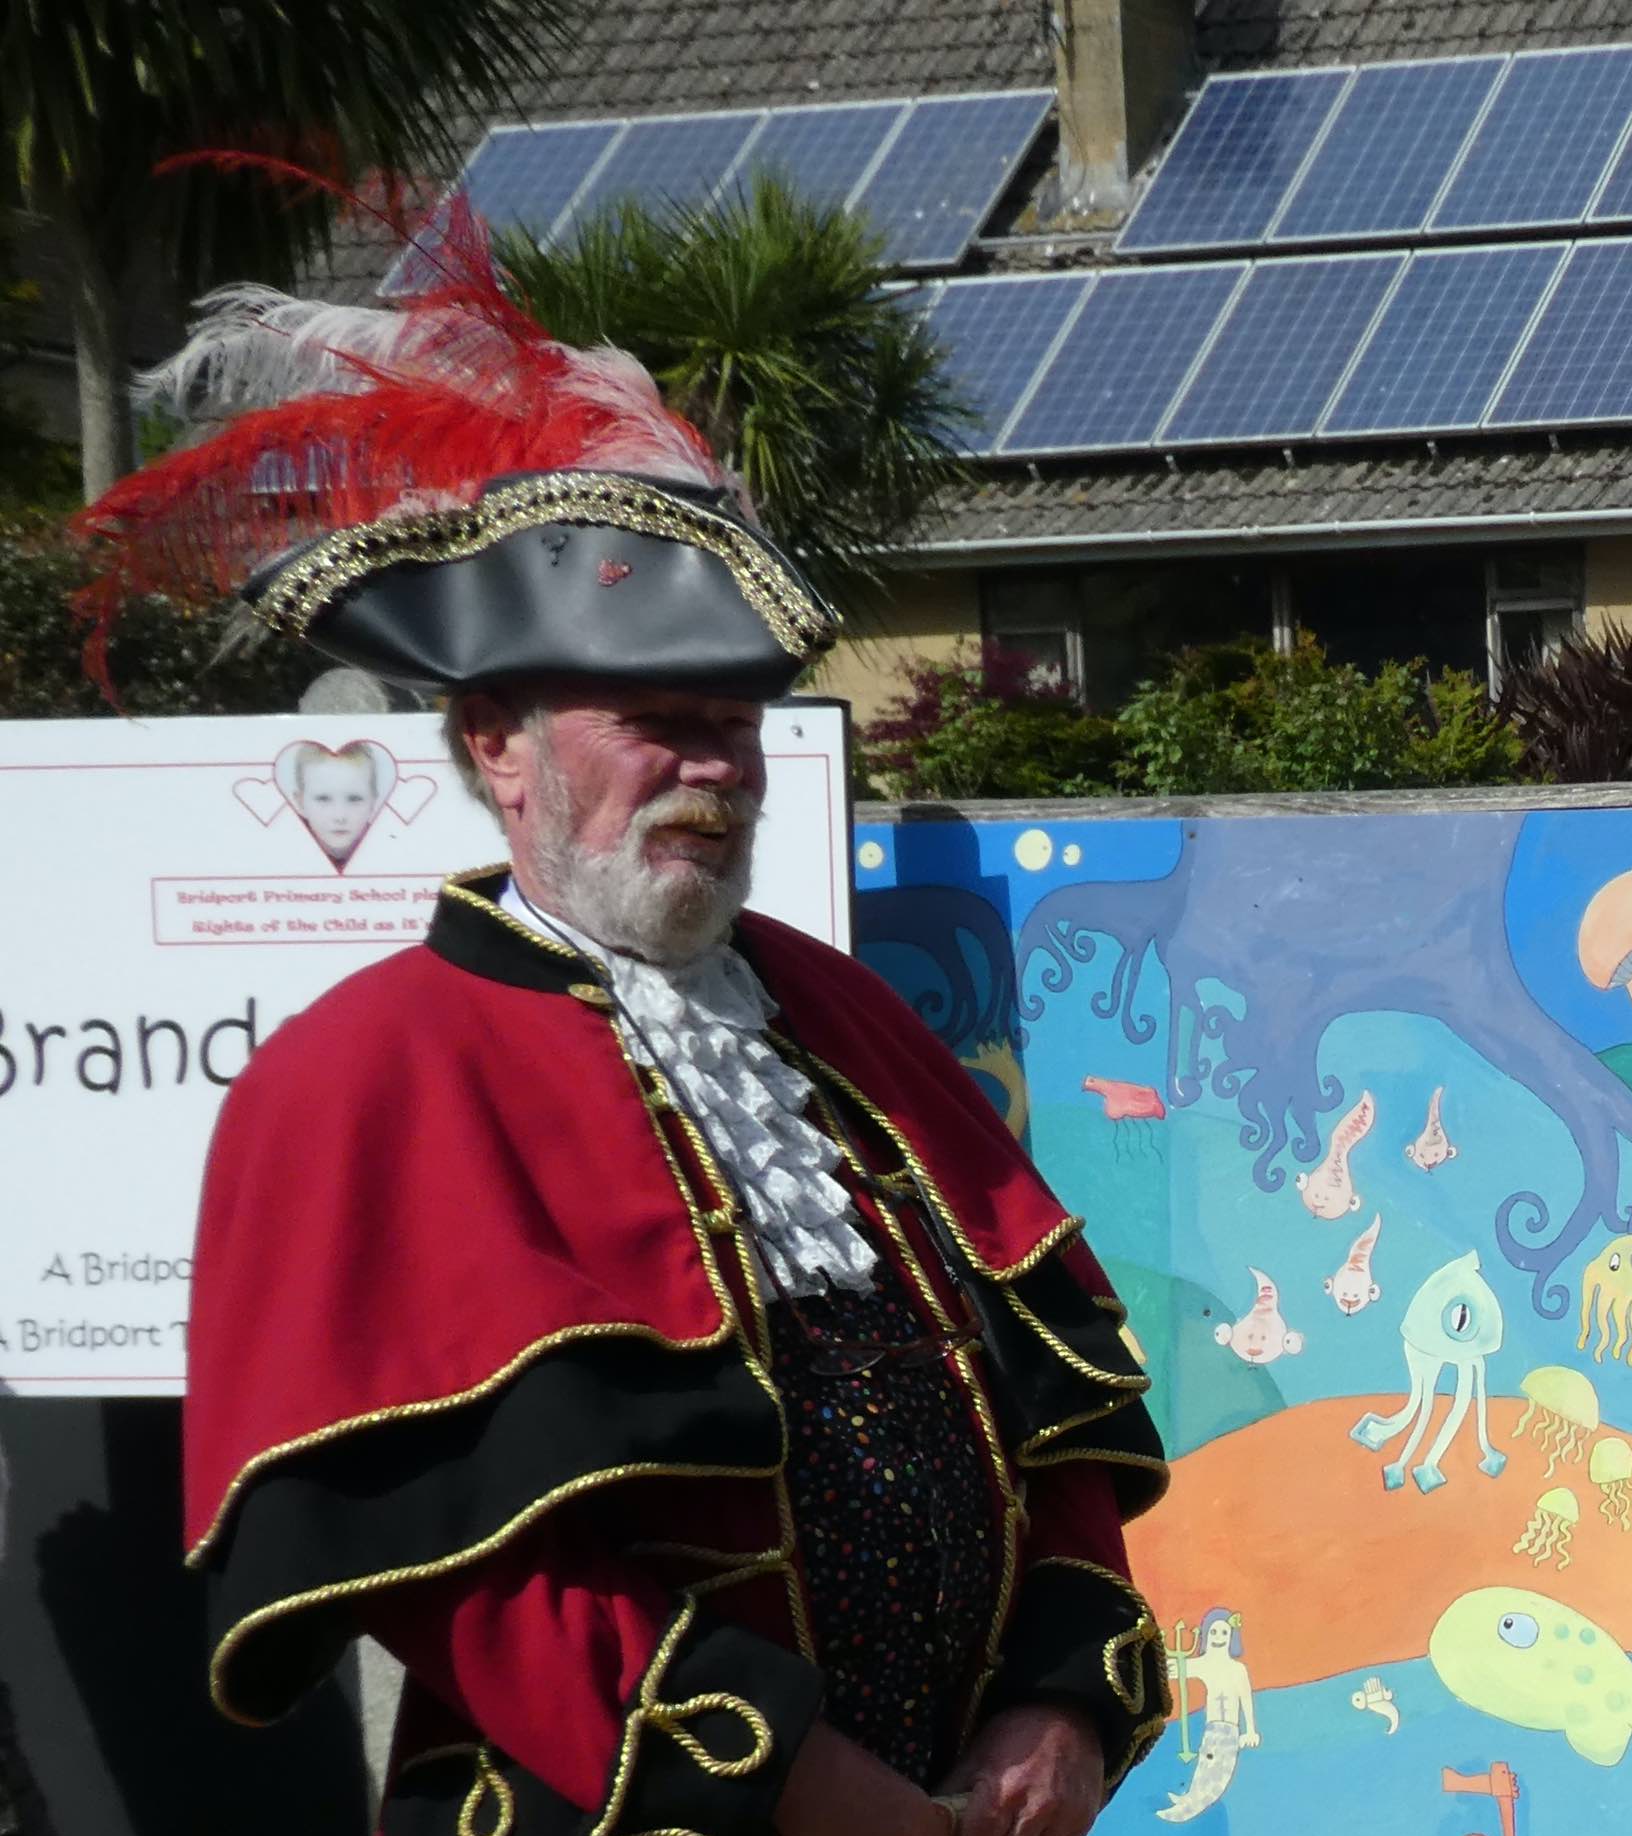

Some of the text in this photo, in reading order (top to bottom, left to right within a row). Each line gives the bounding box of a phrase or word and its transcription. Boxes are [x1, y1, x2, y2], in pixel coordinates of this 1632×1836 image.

[177, 891, 257, 906] Bridport
[263, 890, 342, 904] Primary
[350, 888, 406, 902] School
[192, 921, 254, 934] Rights
[260, 919, 280, 933] of
[286, 917, 317, 932] the
[323, 917, 367, 932] Child
[373, 922, 395, 930] as
[40, 1253, 72, 1285] A
[17, 1317, 162, 1352] Bridport
